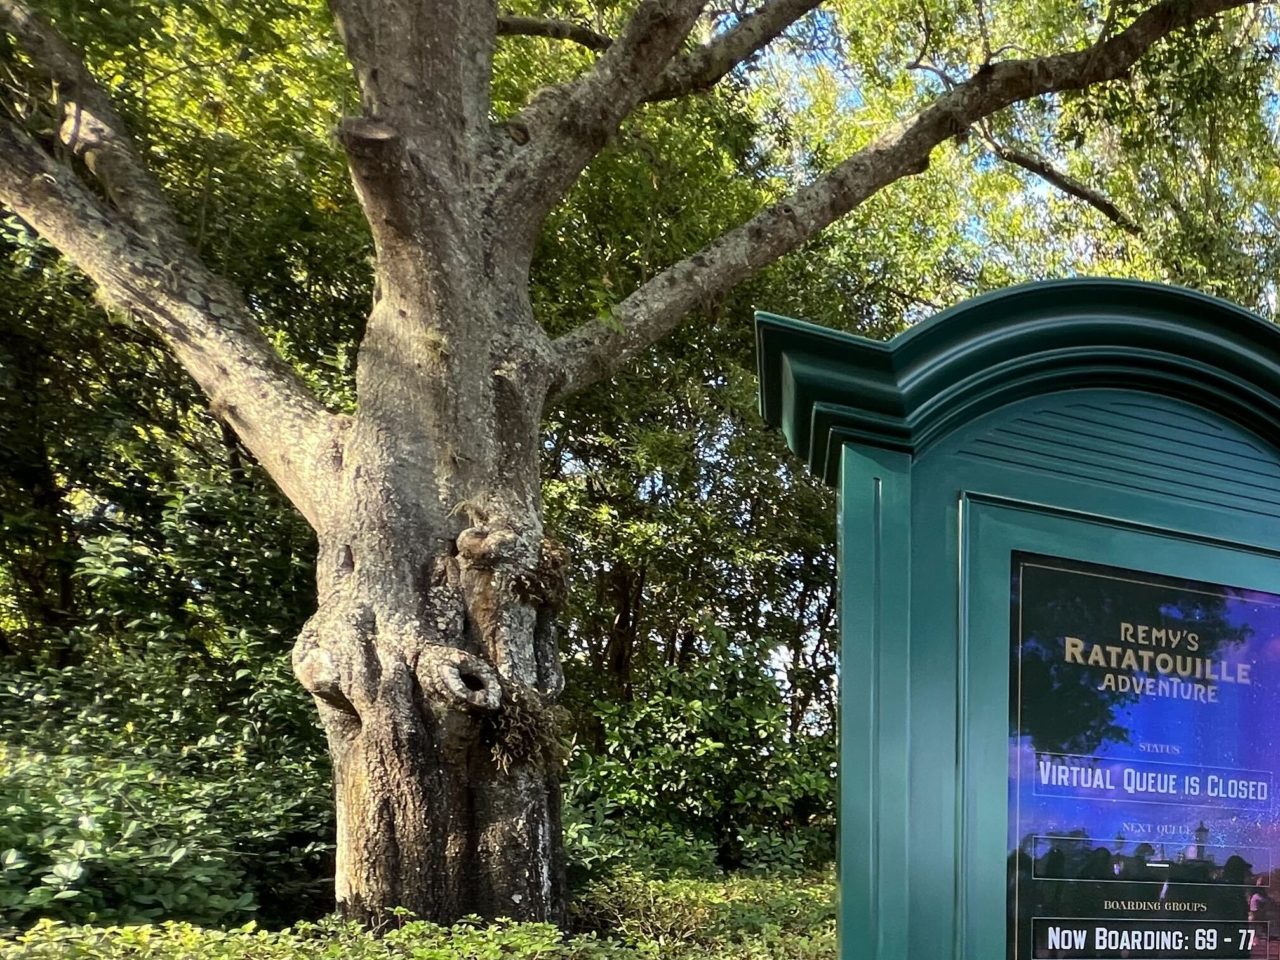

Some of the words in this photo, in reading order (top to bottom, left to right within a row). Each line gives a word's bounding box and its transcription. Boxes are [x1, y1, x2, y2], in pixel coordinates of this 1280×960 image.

[1119, 621, 1200, 652] REMY'S
[1064, 636, 1252, 685] RATATOUILLE
[1097, 673, 1219, 704] ADVENTURE
[1138, 742, 1181, 755] STATUS
[1039, 761, 1115, 790] VIRTUAL
[1123, 768, 1177, 794] QUEUE
[1184, 775, 1200, 796] IS
[1207, 775, 1268, 800] CLOSED
[1122, 822, 1153, 834] NEXT
[1104, 899, 1161, 911] BOARDING
[1164, 901, 1208, 912] GROUPS
[1048, 926, 1087, 950] NOW
[1095, 927, 1189, 951] BOARDING:
[1194, 928, 1218, 951] 69
[1238, 929, 1255, 951] 77
